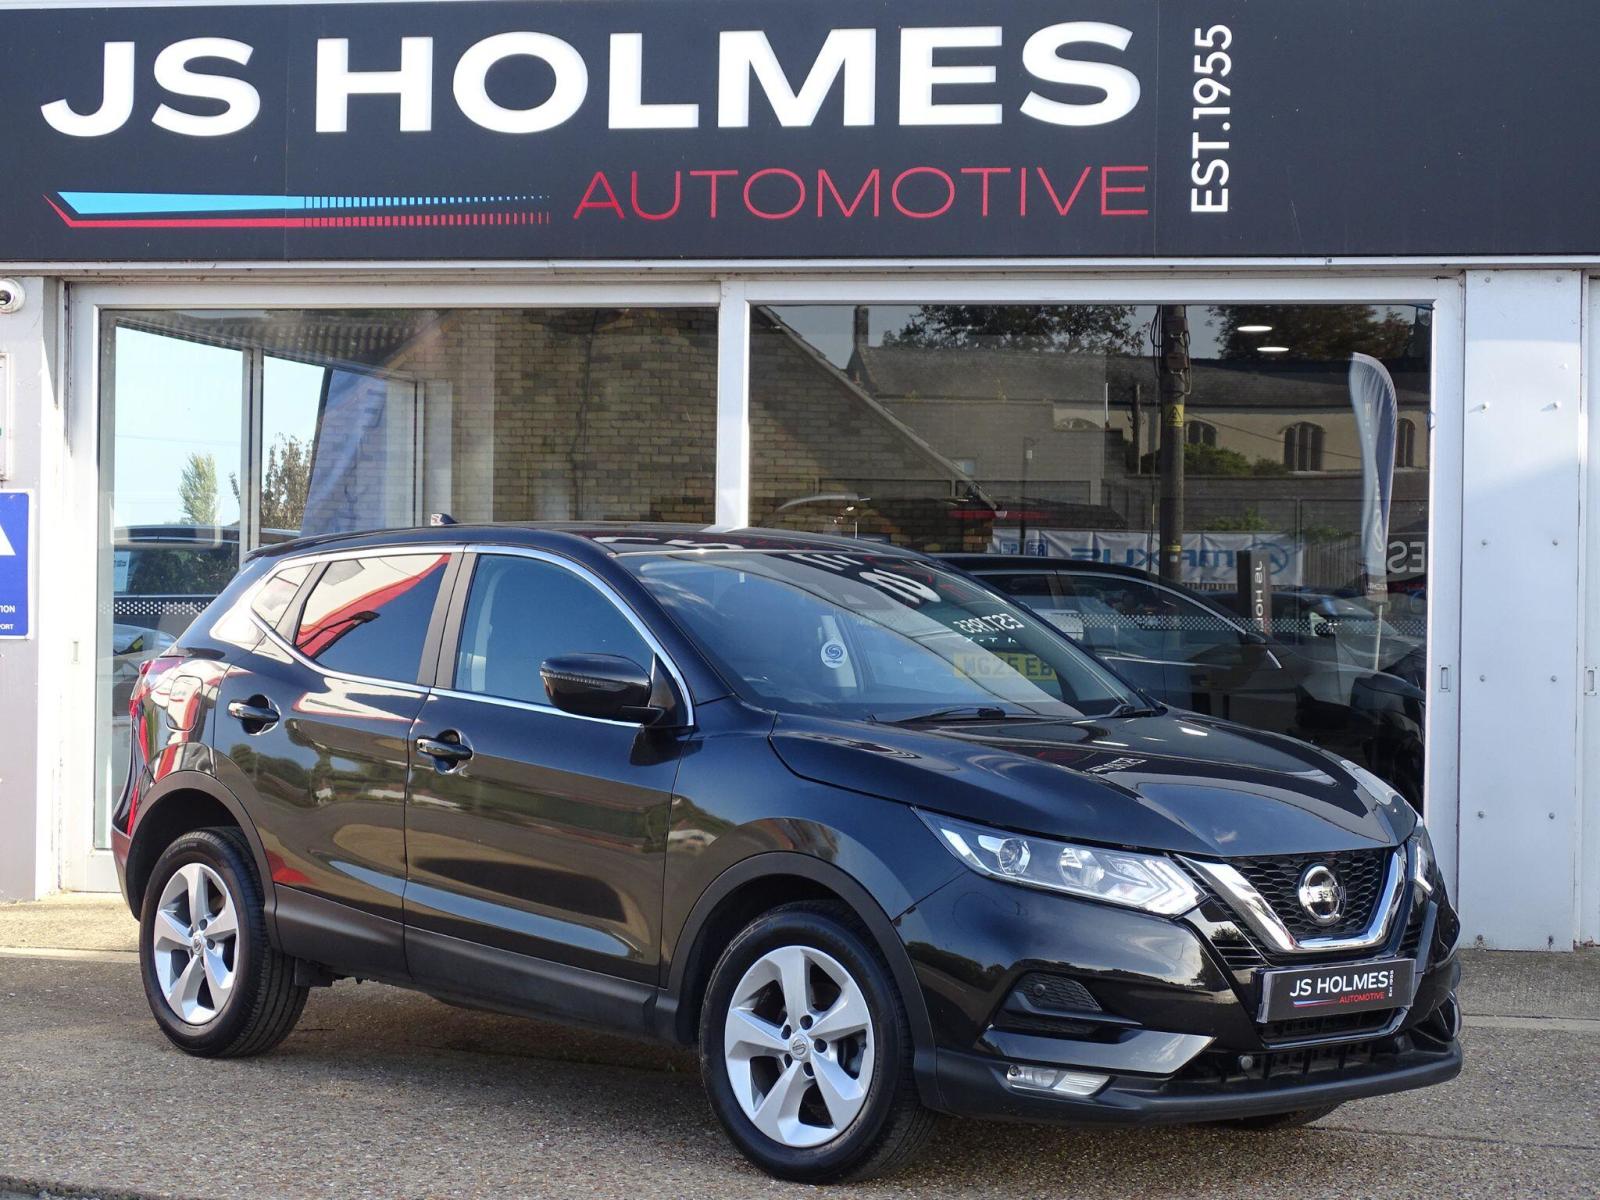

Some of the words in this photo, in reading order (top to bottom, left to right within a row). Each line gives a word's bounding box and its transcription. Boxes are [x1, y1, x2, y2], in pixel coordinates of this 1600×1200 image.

[41, 38, 261, 137] JS
[315, 21, 1141, 134] HOLMES
[1190, 24, 1233, 213] EST.1955
[573, 165, 1149, 221] AUTOMOTIVE
[1290, 978, 1313, 997] JS
[1316, 970, 1388, 994] HOLMES
[1339, 991, 1385, 1004] AUTOMOTIVE
